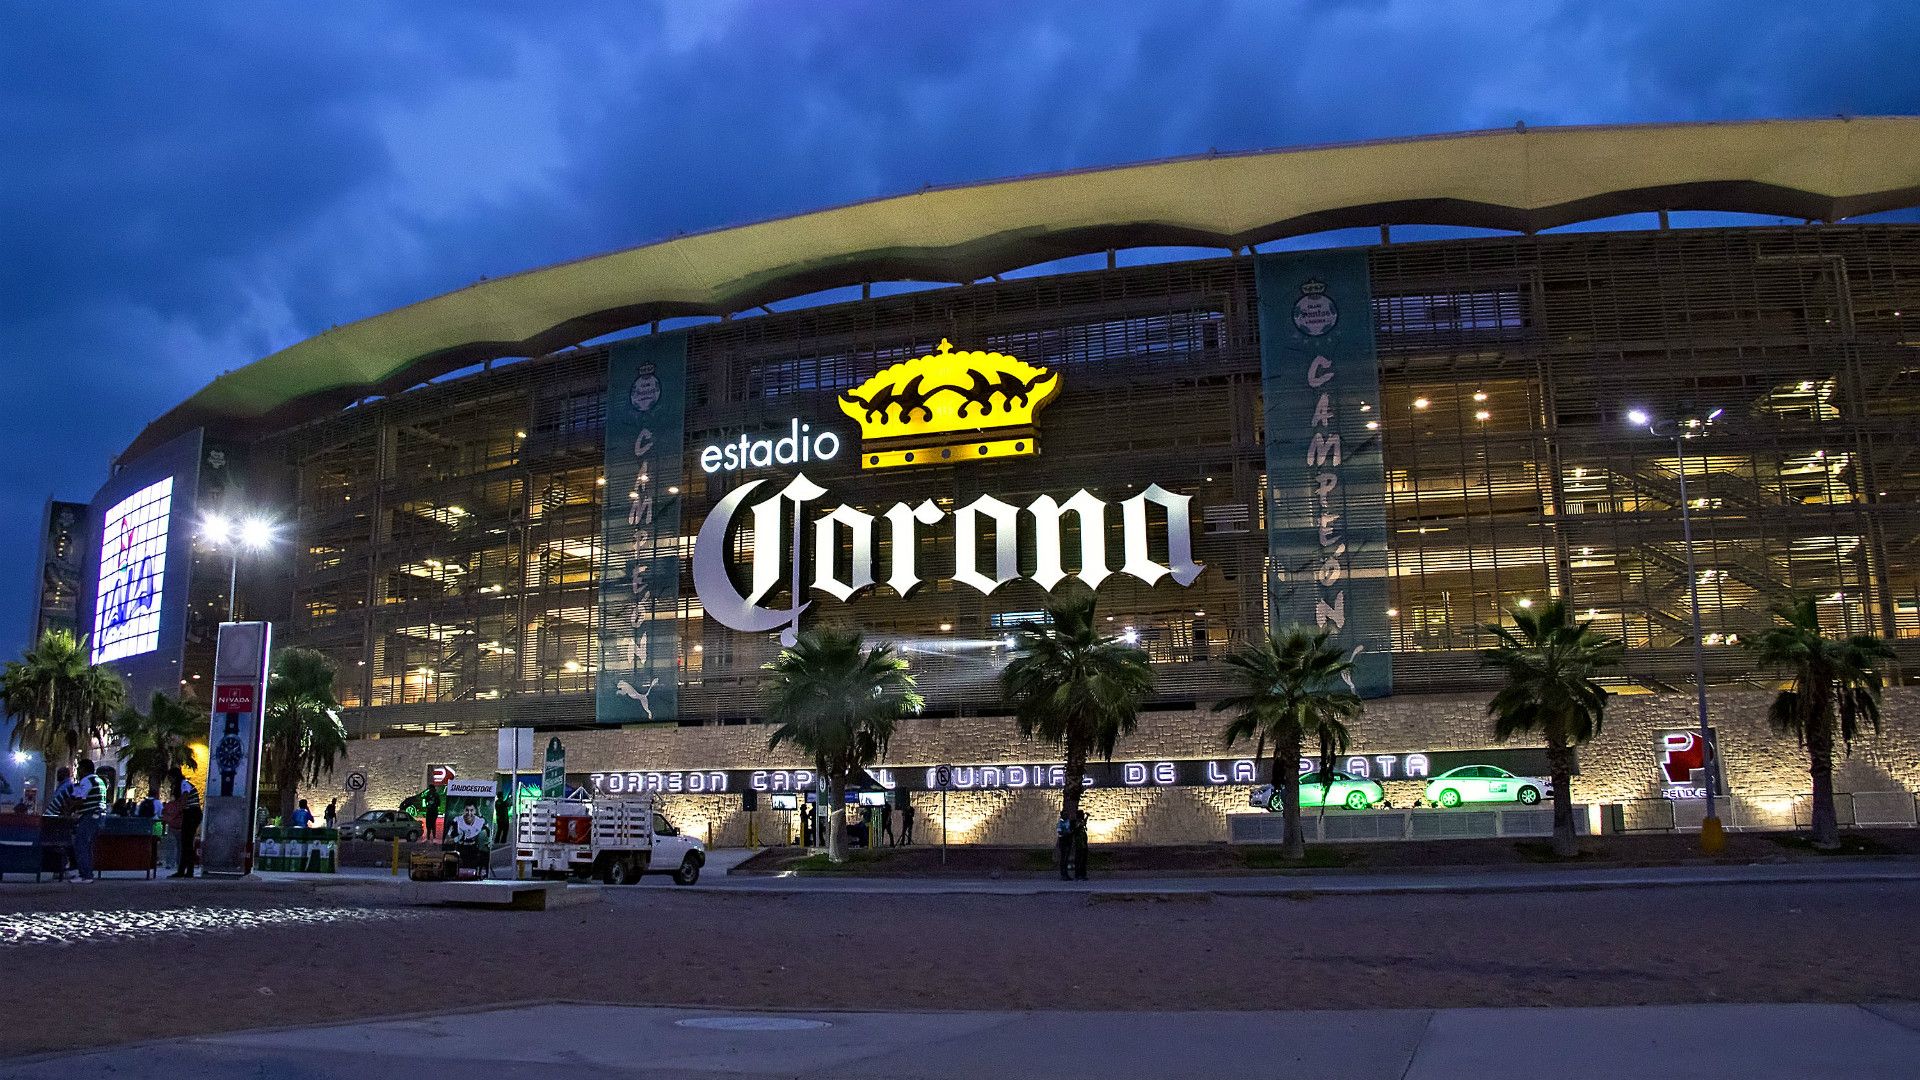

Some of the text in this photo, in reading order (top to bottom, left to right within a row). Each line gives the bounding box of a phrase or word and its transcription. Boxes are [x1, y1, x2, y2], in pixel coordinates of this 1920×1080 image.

[700, 417, 840, 473] estadio
[692, 472, 1207, 648] Corona
[450, 783, 492, 793] BRIDGESTONE
[591, 773, 727, 792] TORREON
[1125, 762, 1174, 784] DE
[1209, 760, 1256, 782] LA
[1298, 753, 1428, 778] PATA
